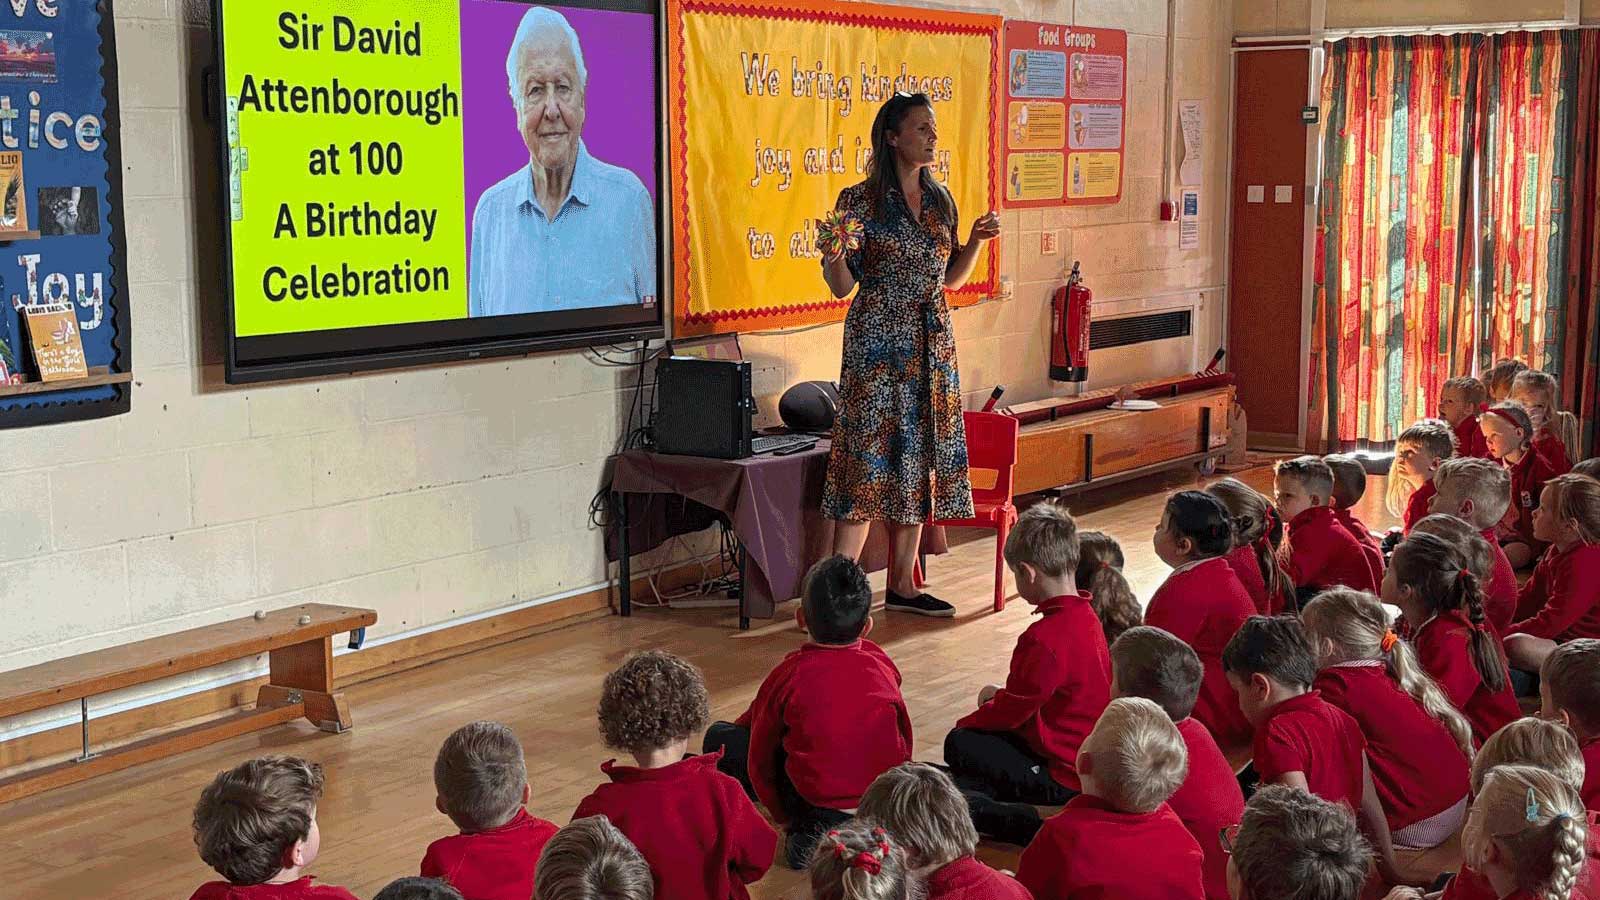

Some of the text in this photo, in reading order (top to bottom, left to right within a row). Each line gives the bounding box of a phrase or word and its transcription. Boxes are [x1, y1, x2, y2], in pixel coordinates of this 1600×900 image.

[278, 11, 421, 57] Sir David
[1038, 25, 1096, 52] Food Groups
[237, 74, 459, 126] Attenborough
[741, 51, 953, 117] We bring kindness
[309, 141, 403, 176] at 100
[750, 138, 792, 191] joy
[803, 135, 845, 174] and
[273, 201, 437, 242] A Birthday
[747, 227, 775, 259] to
[12, 253, 103, 330] Joy
[262, 259, 449, 302] Celebration
